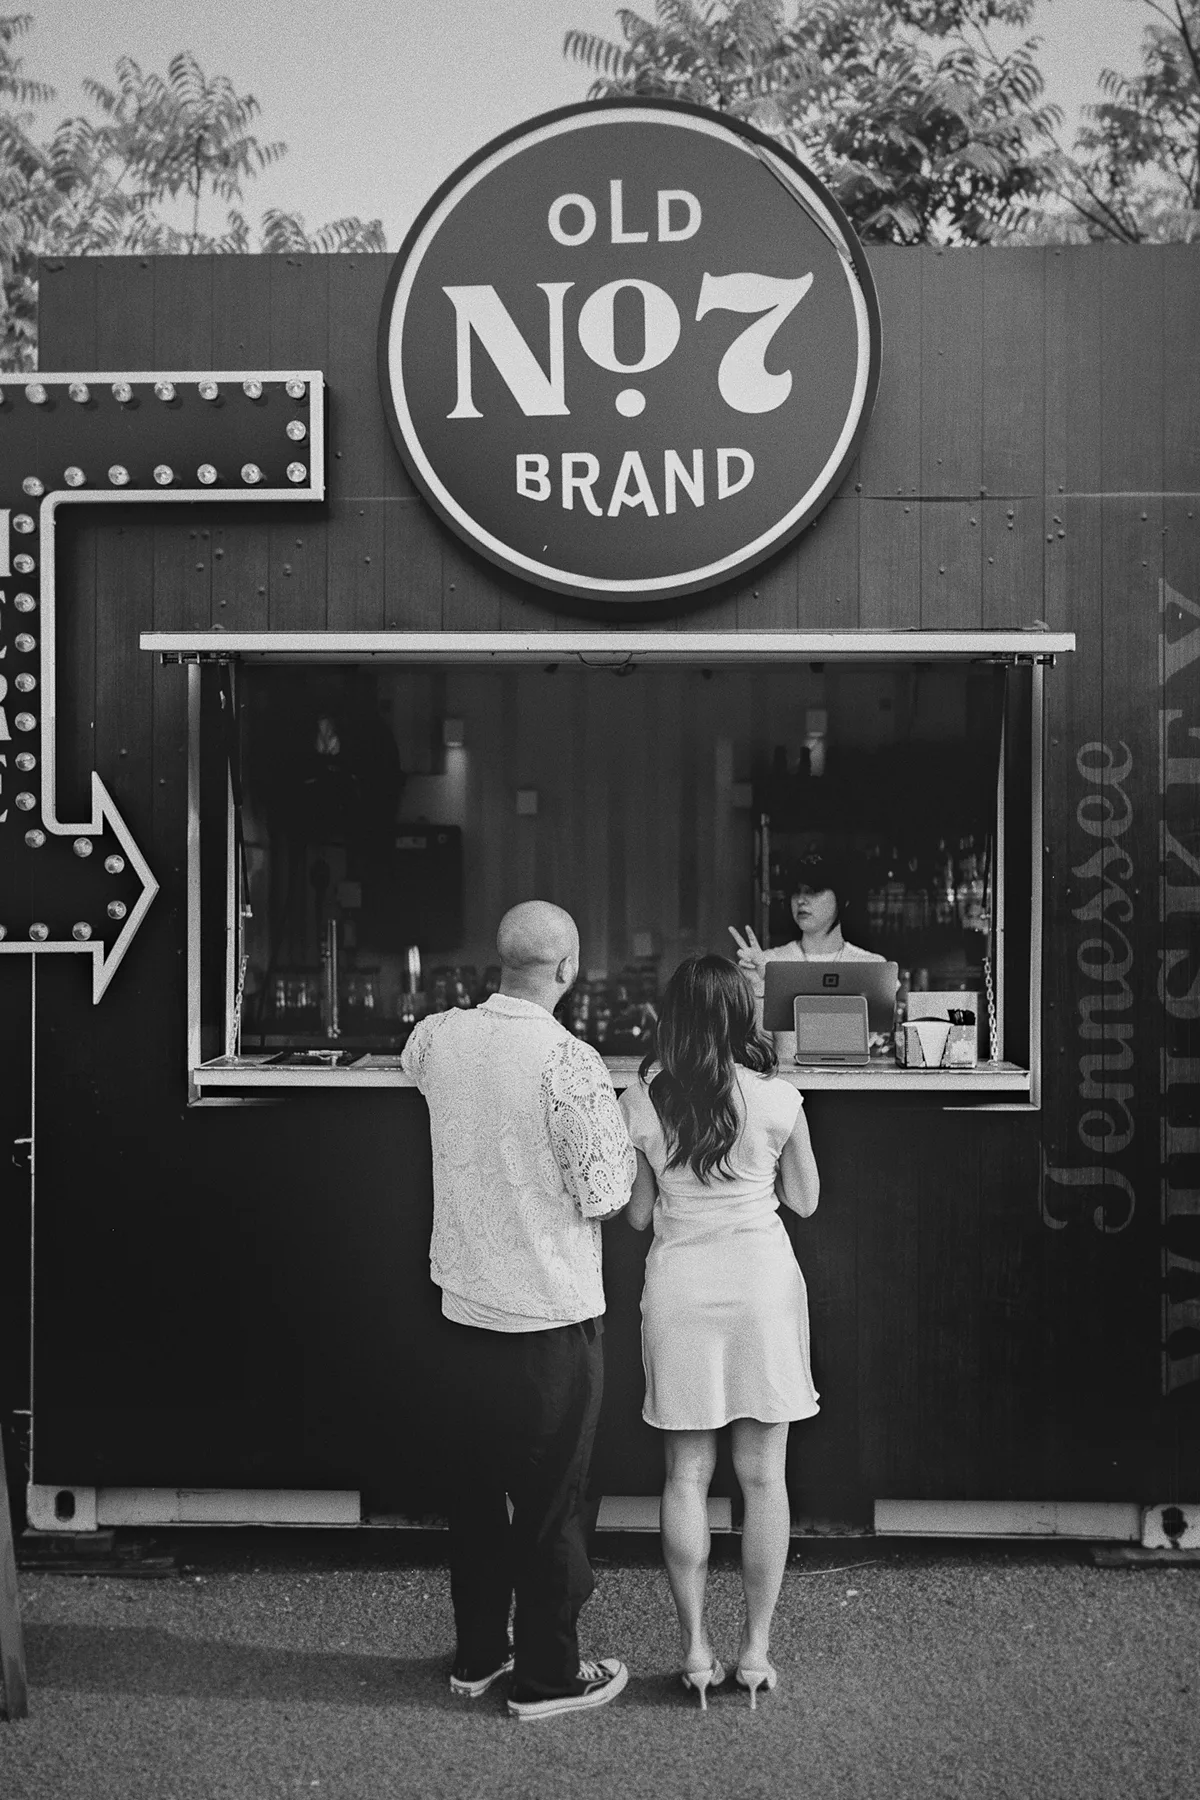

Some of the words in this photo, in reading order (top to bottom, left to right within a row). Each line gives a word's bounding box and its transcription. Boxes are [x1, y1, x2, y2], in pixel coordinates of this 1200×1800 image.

[547, 179, 703, 247] OLD
[516, 447, 755, 518] BRAND
[1037, 740, 1136, 1234] Tennessee
